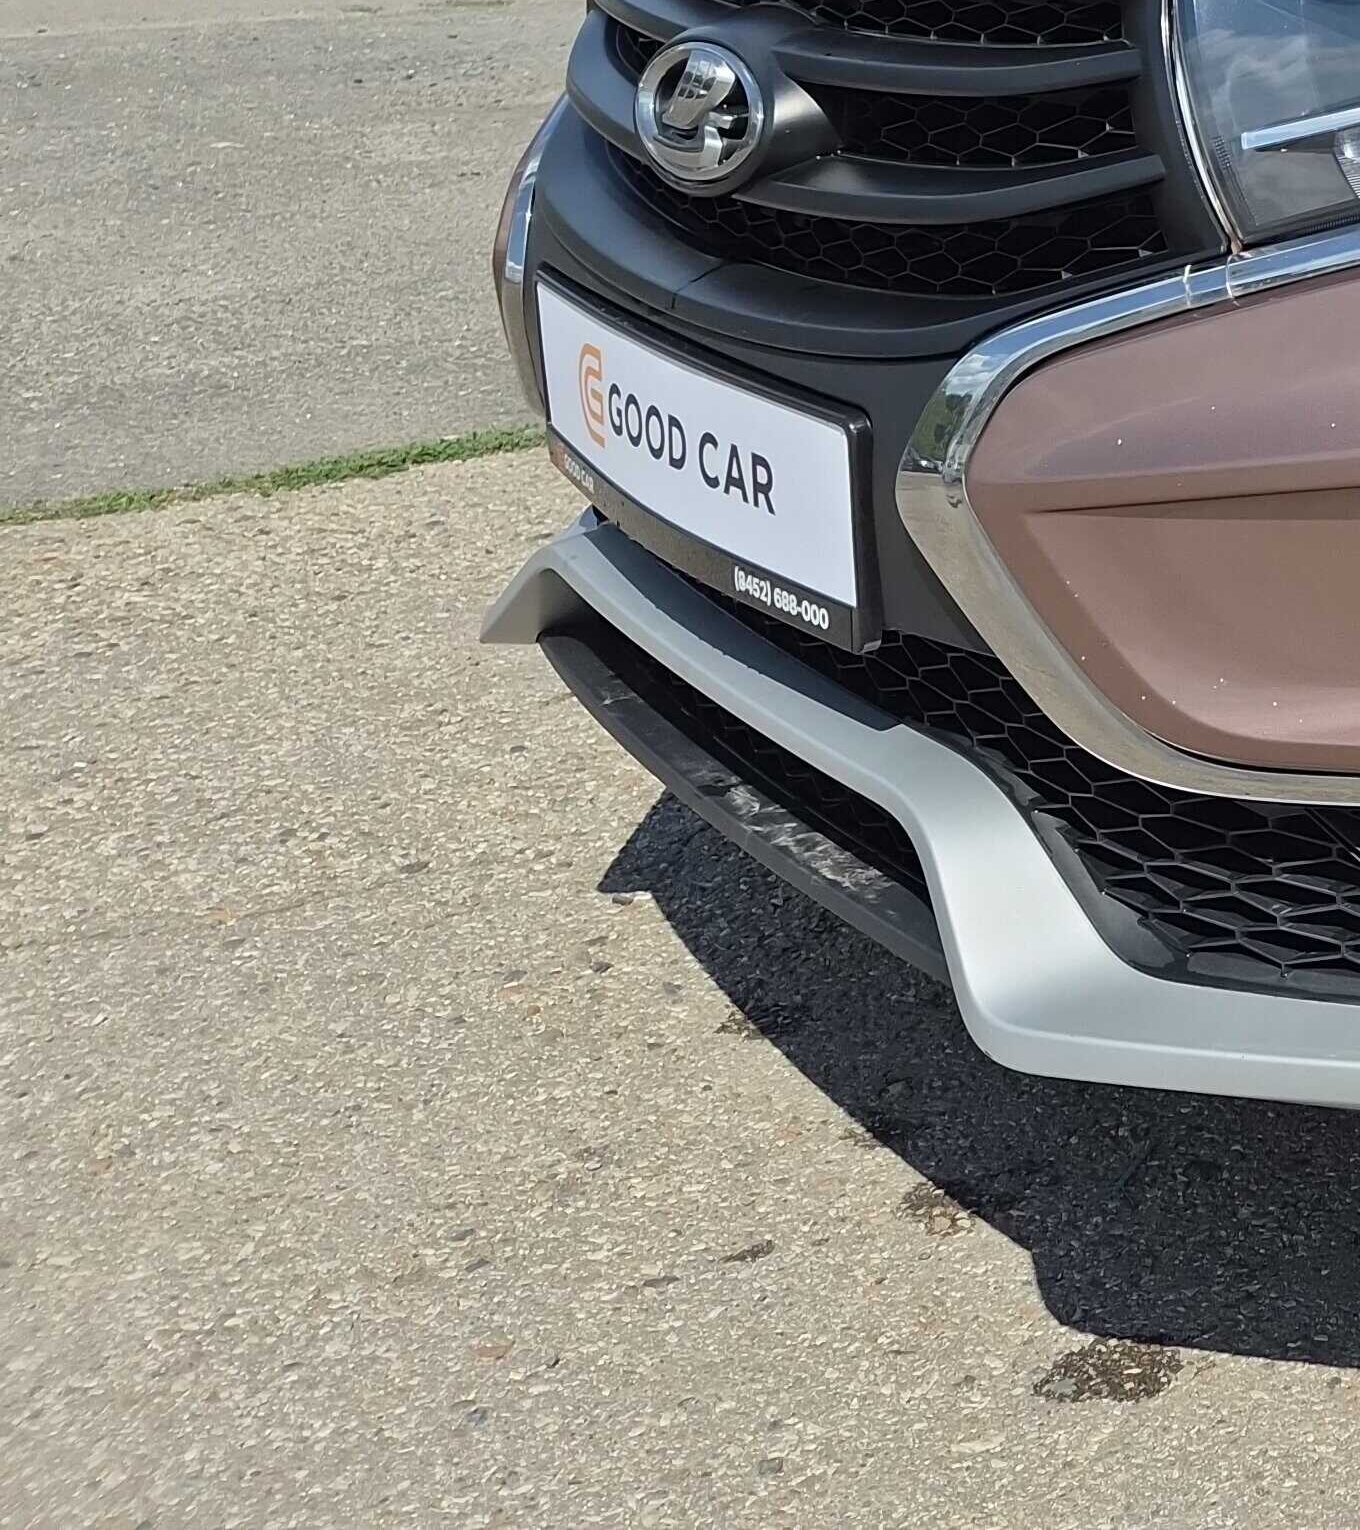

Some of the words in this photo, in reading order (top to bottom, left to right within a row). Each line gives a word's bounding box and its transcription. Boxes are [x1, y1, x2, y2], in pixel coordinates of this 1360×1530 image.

[608, 382, 687, 471] GOOD
[699, 431, 776, 516] CAR
[734, 565, 772, 607] (8452)
[773, 587, 830, 630] 688-000
